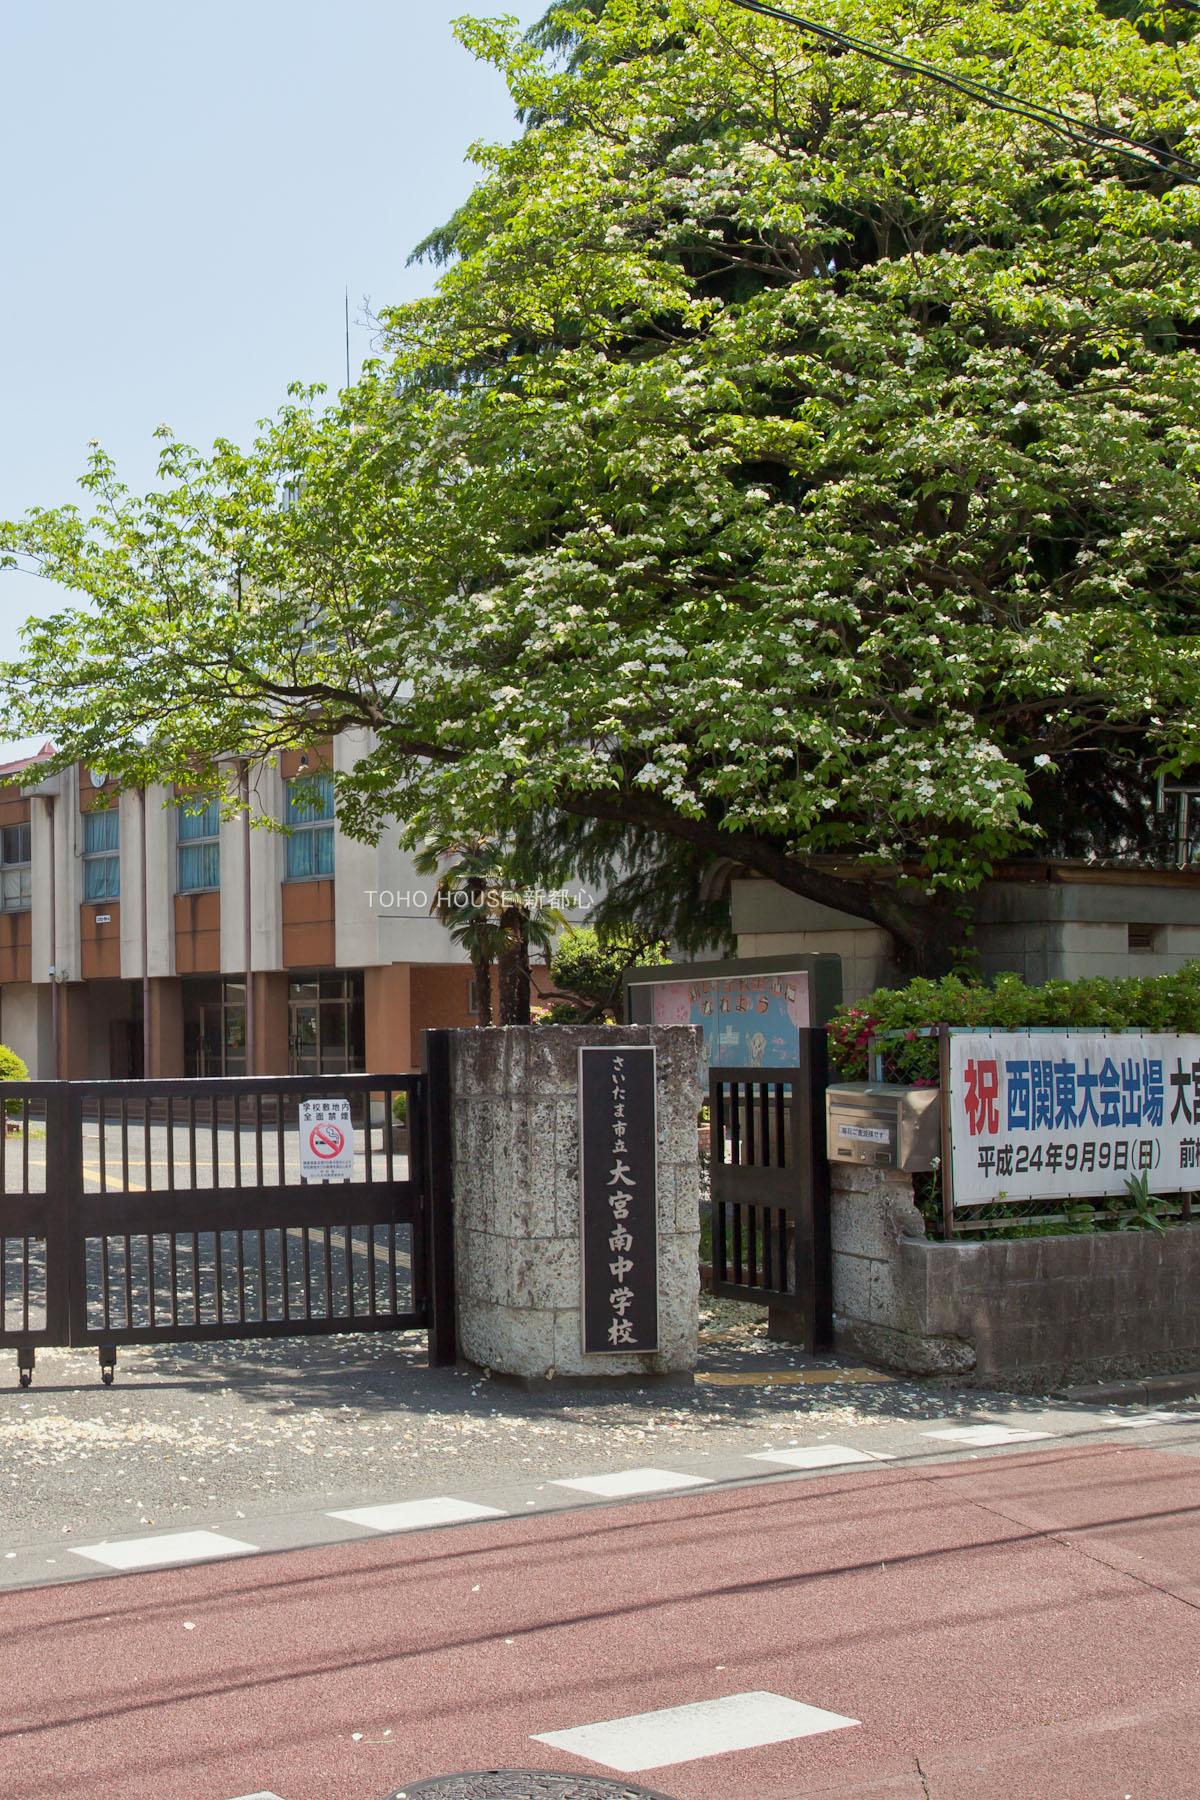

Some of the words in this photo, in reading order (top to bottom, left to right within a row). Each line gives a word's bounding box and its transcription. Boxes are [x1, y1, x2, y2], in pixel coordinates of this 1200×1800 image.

[964, 1059, 1000, 1136] 祝
[1005, 1057, 1164, 1131] 西関東大会出場
[303, 1103, 350, 1112] 学校敷地内
[304, 1113, 349, 1121] 全面禁煙
